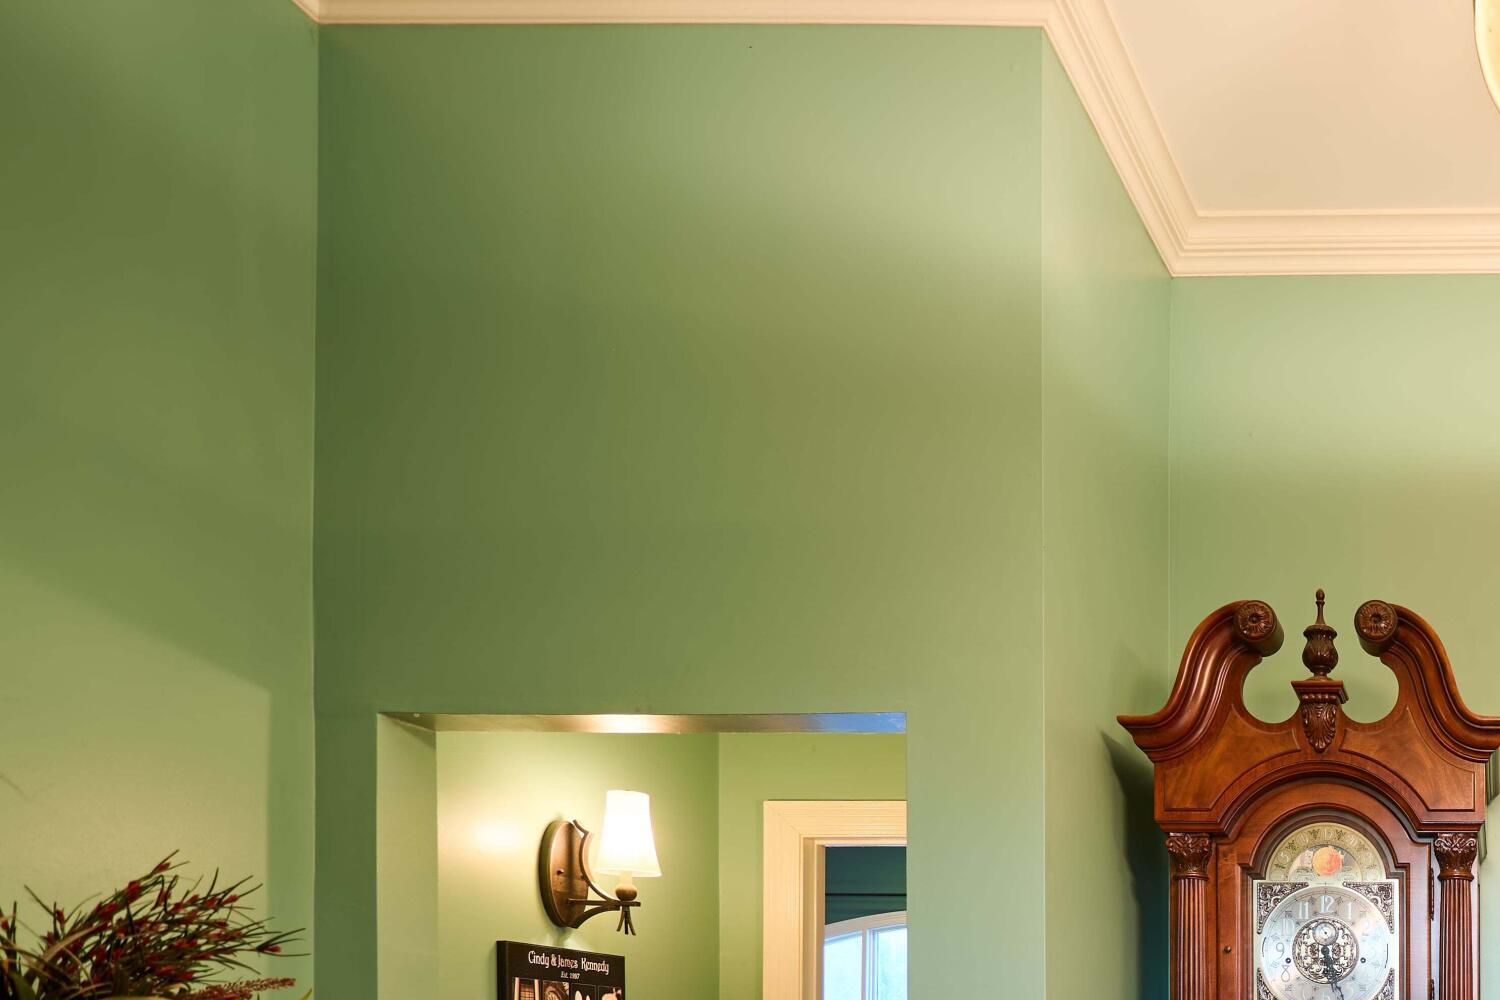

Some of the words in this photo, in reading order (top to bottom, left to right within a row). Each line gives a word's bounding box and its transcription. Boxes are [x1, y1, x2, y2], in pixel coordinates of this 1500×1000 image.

[1320, 895, 1334, 914] 12
[1276, 942, 1285, 959] 9
[528, 950, 550, 969] Cindy
[550, 954, 557, 967] &
[557, 954, 579, 969] James
[581, 957, 609, 975] Kennedy
[1281, 965, 1291, 982] 8
